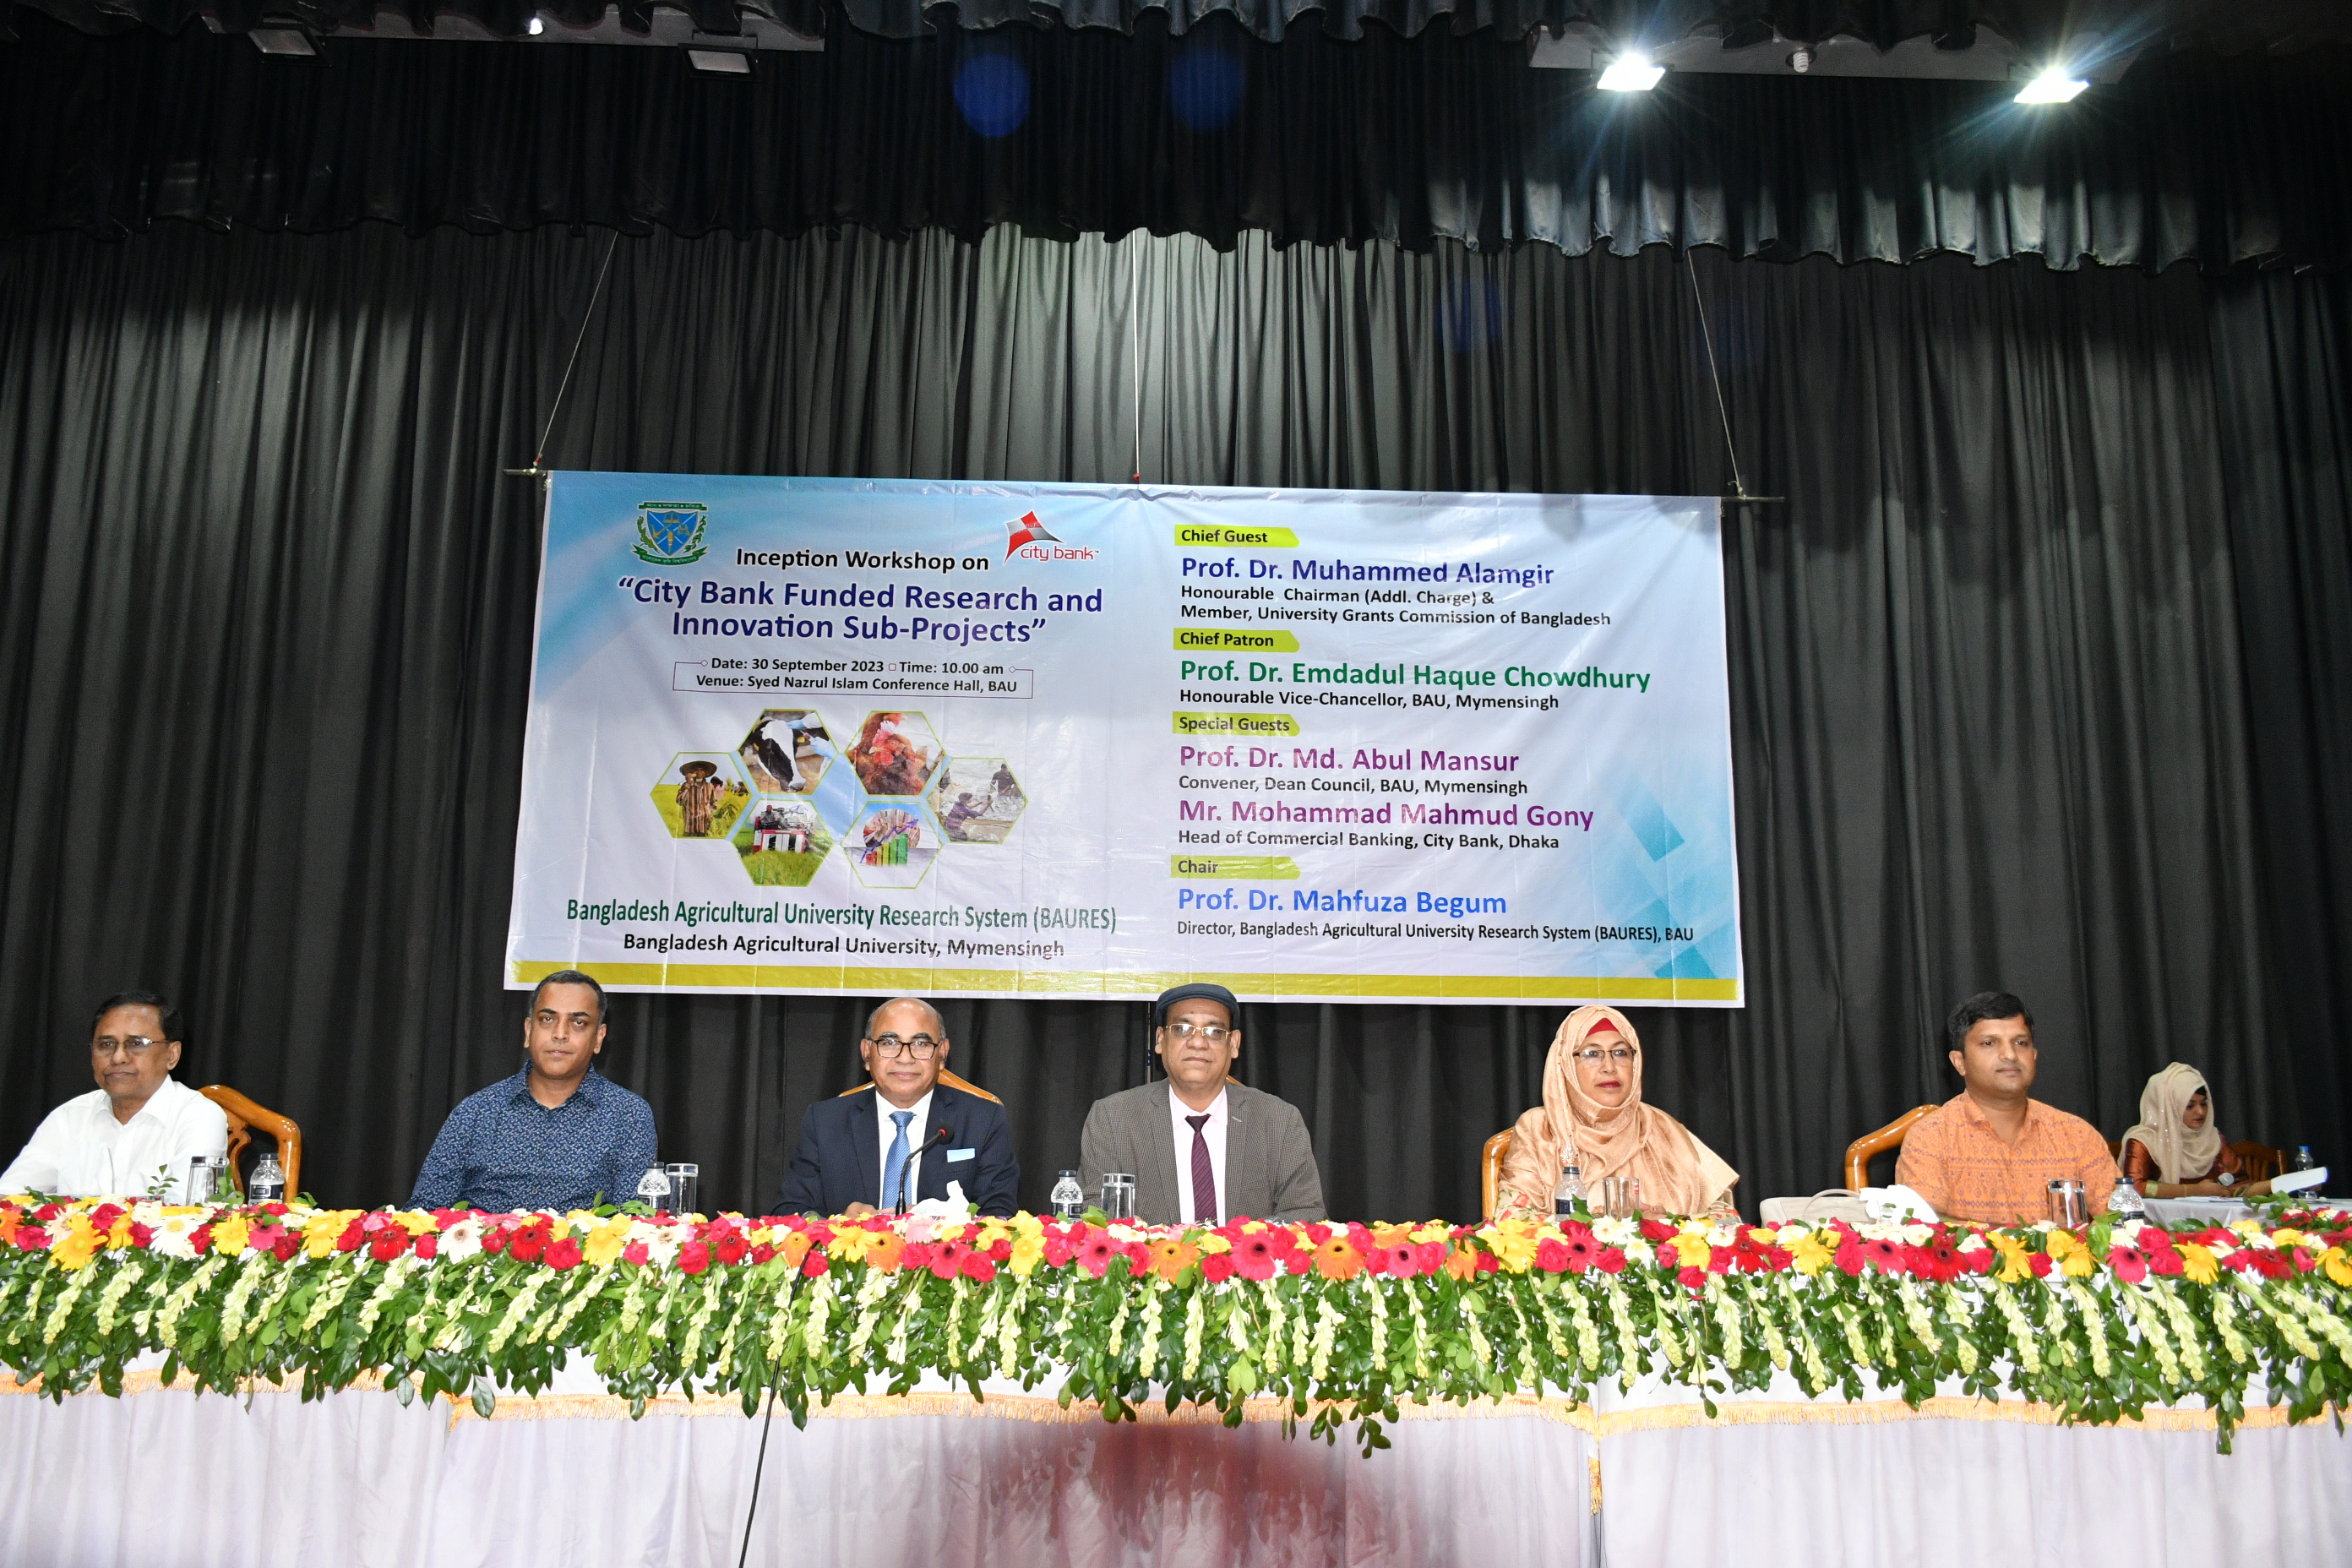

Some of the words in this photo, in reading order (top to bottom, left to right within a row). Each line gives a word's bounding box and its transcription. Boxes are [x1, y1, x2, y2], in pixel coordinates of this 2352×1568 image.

[1181, 528, 1222, 543] Chief
[1223, 529, 1269, 545] Guest
[737, 548, 838, 570] Inception
[845, 550, 956, 574] Workshop
[961, 558, 988, 570] on
[1020, 544, 1050, 562] city
[1182, 557, 1240, 578] Prof.
[1250, 559, 1282, 580] Dr.
[1293, 558, 1448, 583] Muhammed
[1456, 562, 1554, 588] Alamgir
[618, 577, 692, 609] “City
[700, 580, 775, 605] Bank
[784, 583, 895, 608] Funded
[905, 585, 1037, 611] Research
[1048, 588, 1102, 612] and
[1181, 585, 1274, 600] Honourable
[1283, 587, 1359, 602] Chairman
[1364, 588, 1412, 606] (Addl.
[1416, 590, 1477, 607] Charge)
[1481, 591, 1494, 605] &
[1181, 604, 1253, 622] Member,
[1258, 607, 1338, 624] University
[1342, 608, 1395, 623] Grants
[1399, 610, 1495, 623] Commission
[1500, 610, 1516, 624] of
[1521, 611, 1611, 629] Bangladesh
[672, 612, 833, 638] Innovation
[843, 614, 1046, 647] Sub-Projects”
[1179, 632, 1220, 647] Chief
[1222, 633, 1274, 648] Patron
[711, 657, 748, 669] Date:
[751, 658, 769, 670] 30
[771, 658, 847, 673] September
[851, 660, 885, 672] 2023
[899, 661, 937, 673] Time:
[941, 662, 978, 674] 10.00
[981, 665, 1004, 675] am
[1181, 660, 1239, 682] Prof.
[1250, 662, 1283, 683] Dr.
[1293, 662, 1404, 685] Emdadul
[1413, 664, 1496, 691] Haque
[1504, 665, 1651, 694] Chowdhury
[696, 674, 743, 687] Venue:
[747, 675, 780, 690] Syed
[784, 676, 828, 689] Nazrul
[832, 677, 868, 689] Islam
[872, 678, 950, 691] Conference
[954, 679, 984, 694] Hall,
[988, 680, 1017, 693] BAU
[1180, 689, 1274, 705] Honourable
[1278, 691, 1407, 709] Vice-Chancellor,
[1413, 694, 1451, 710] BAU,
[1456, 694, 1559, 711] Mymensingh
[1179, 716, 1234, 733] Special
[1237, 717, 1291, 732] Guests
[1180, 745, 1239, 768] Prof.
[1249, 747, 1283, 768] Dr.
[1293, 747, 1343, 770] Md.
[1352, 748, 1411, 770] Abul
[1421, 750, 1520, 772] Mansur
[1179, 775, 1260, 792] Convener,
[1265, 776, 1306, 791] Dean
[1310, 777, 1375, 795] Council,
[1380, 779, 1419, 795] BAU,
[1424, 779, 1527, 798] Mymensingh
[1179, 799, 1222, 821] Mr.
[1232, 800, 1391, 825] Mohammad
[1401, 802, 1518, 826] Mahmud
[1527, 805, 1594, 832] Gony
[1179, 830, 1220, 844] Head
[1225, 830, 1243, 844] of
[1247, 830, 1343, 846] Commercial
[1348, 832, 1418, 850] Banking,
[1423, 833, 1454, 851] City
[1459, 833, 1504, 851] Bank,
[1509, 834, 1560, 849] Dhaka
[1177, 859, 1219, 874] Chair
[1179, 887, 1239, 911] Prof.
[1249, 889, 1283, 911] Dr.
[1293, 889, 1407, 912] Mahfuza
[1417, 891, 1506, 919] Begum
[567, 898, 670, 926] Bangladesh
[674, 901, 779, 928] Agricultural
[784, 902, 875, 930] University
[879, 904, 959, 927] Research
[964, 906, 1027, 933] System
[1033, 906, 1117, 934] (BAURES)
[1178, 920, 1236, 938] Director,
[1240, 921, 1319, 939] Bangladesh
[1321, 922, 1402, 940] Agricultural
[1406, 923, 1475, 942] University
[1478, 924, 1539, 939] Research
[1543, 925, 1591, 943] System
[1594, 925, 1662, 945] (BAURES),
[1664, 927, 1694, 941] BAU
[623, 933, 728, 954] Bangladesh
[732, 935, 840, 956] Agricultural
[846, 937, 941, 958] University,
[947, 939, 1064, 961] Mymensingh
